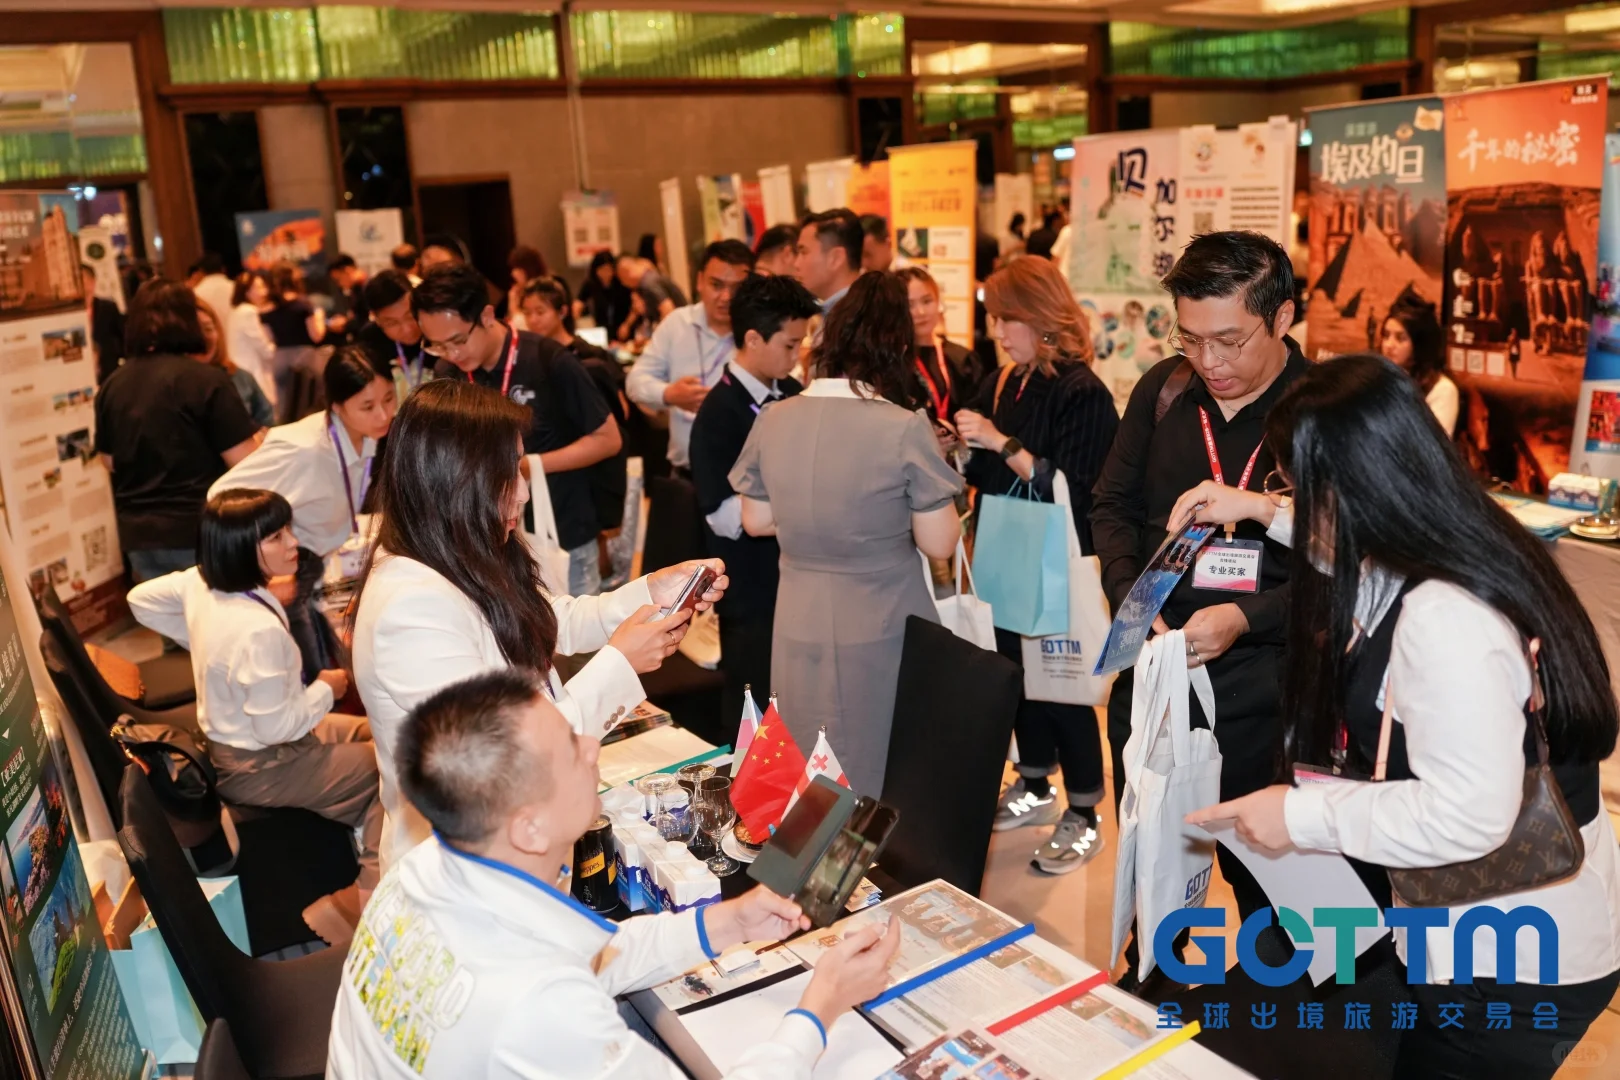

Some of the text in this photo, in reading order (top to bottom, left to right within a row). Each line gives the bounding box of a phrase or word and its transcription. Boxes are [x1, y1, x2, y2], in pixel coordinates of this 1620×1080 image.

[1320, 134, 1424, 184] 埃及约旦
[1457, 120, 1580, 173] 千年的秘密
[1208, 564, 1246, 577] 专业买家
